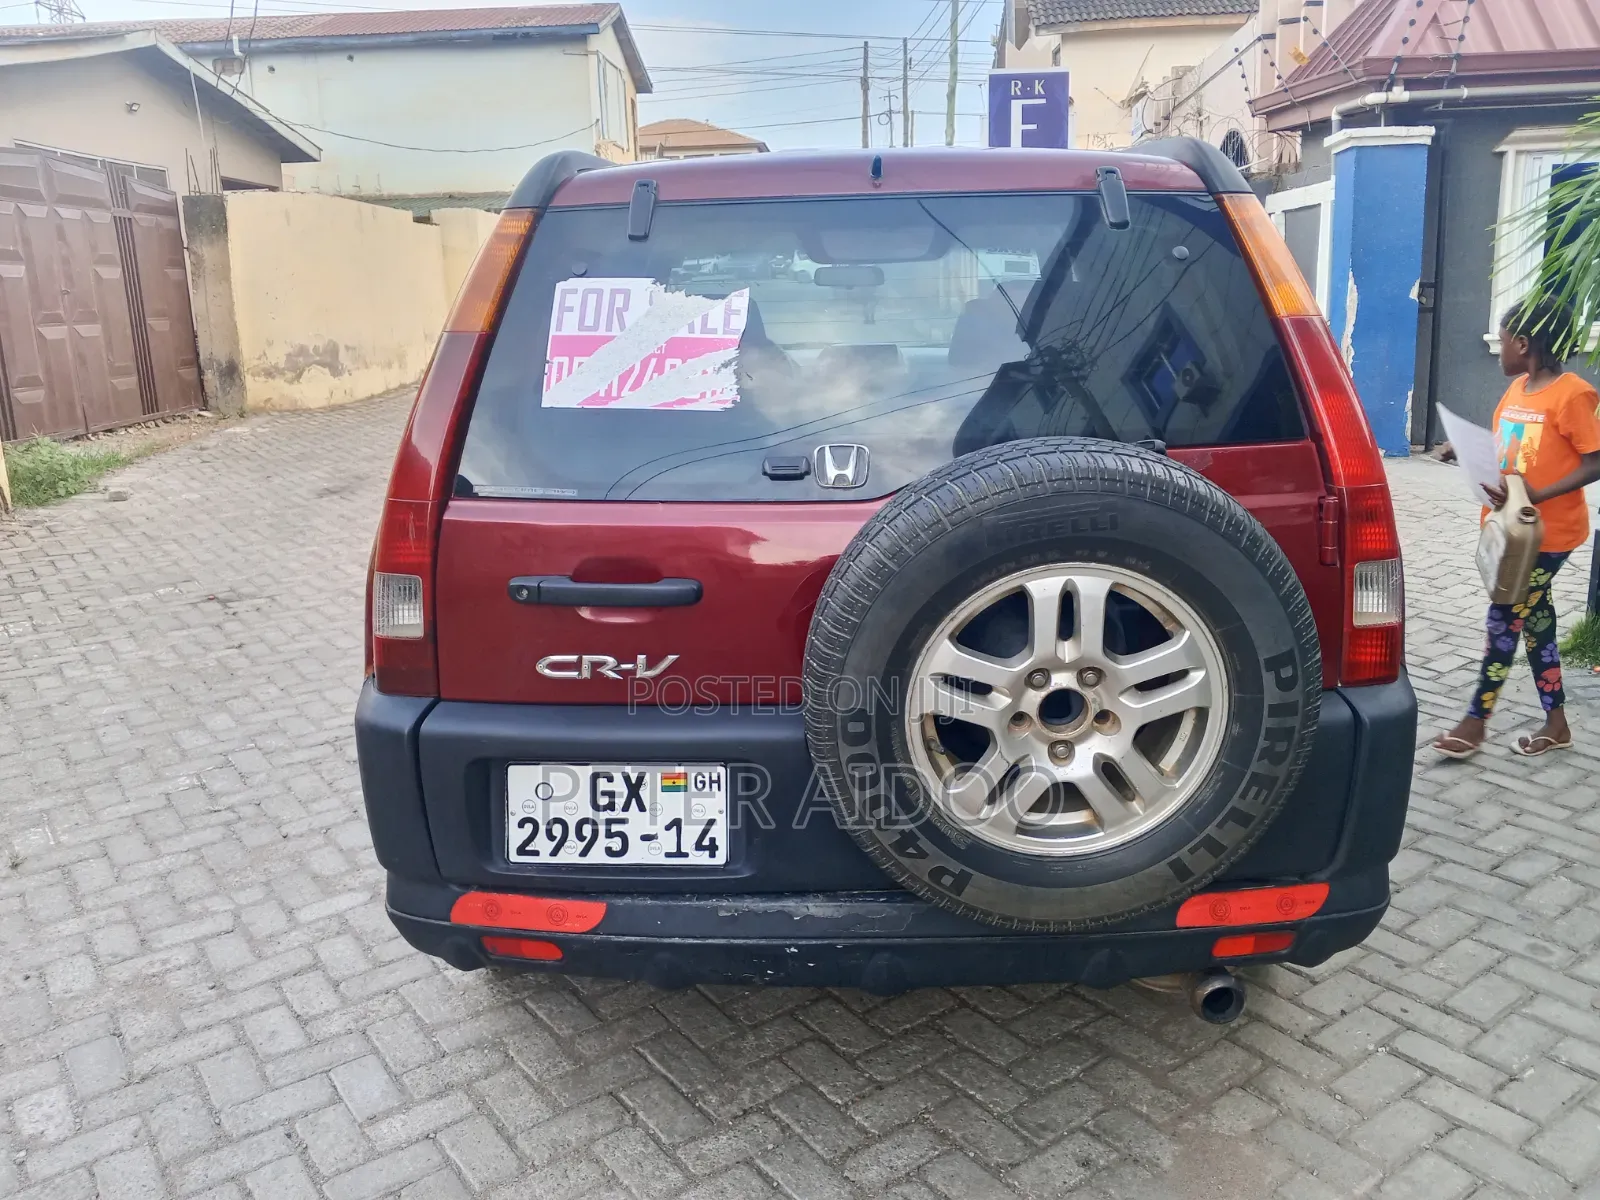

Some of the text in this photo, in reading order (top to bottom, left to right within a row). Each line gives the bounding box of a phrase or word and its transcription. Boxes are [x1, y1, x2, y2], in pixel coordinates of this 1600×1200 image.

[555, 287, 631, 332] FOR
[535, 654, 681, 680] CR-V
[694, 771, 722, 792] GH
[1166, 648, 1300, 884] PIRELLI
[589, 771, 647, 813] GX
